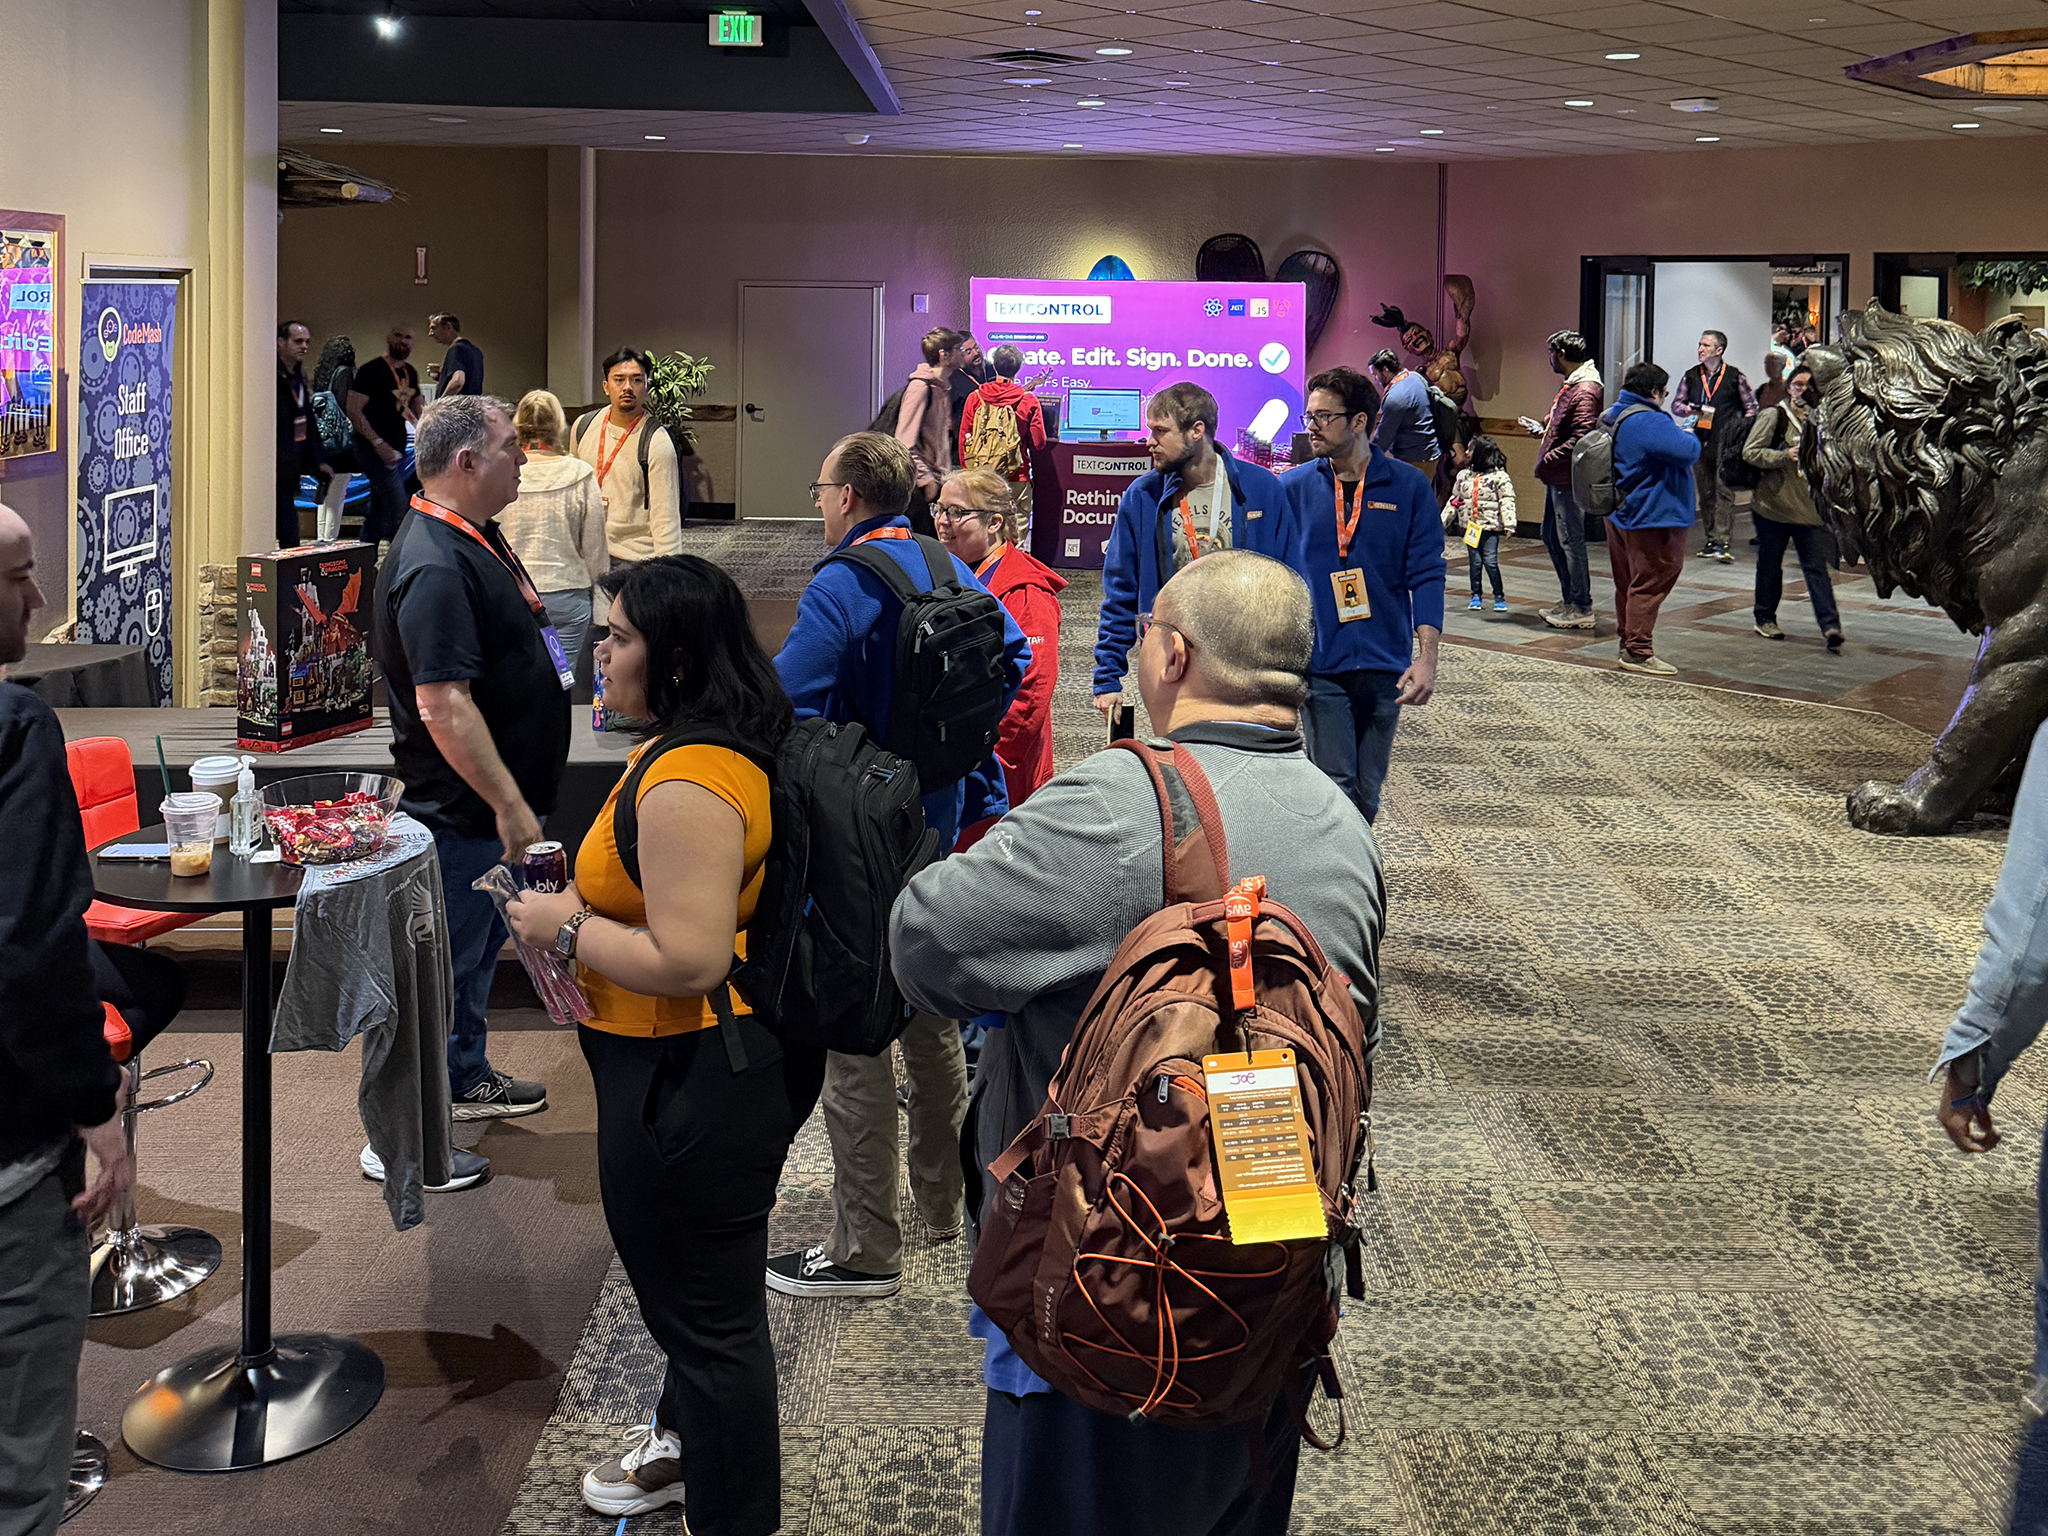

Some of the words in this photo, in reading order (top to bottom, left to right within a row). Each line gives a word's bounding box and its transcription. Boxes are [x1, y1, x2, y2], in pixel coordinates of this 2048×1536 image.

[718, 15, 755, 43] EXIT
[123, 322, 162, 345] CodeMash
[1071, 346, 1121, 366] Edit.
[1127, 347, 1182, 371] Sign.
[1187, 349, 1254, 368] Done.
[1061, 376, 1093, 389] Easy.
[117, 382, 147, 416] Staff
[114, 427, 149, 460] Office
[1066, 489, 1125, 506] Rethin
[1027, 635, 1045, 645] TAFF
[523, 877, 559, 894] bbly
[1226, 903, 1252, 916] aws
